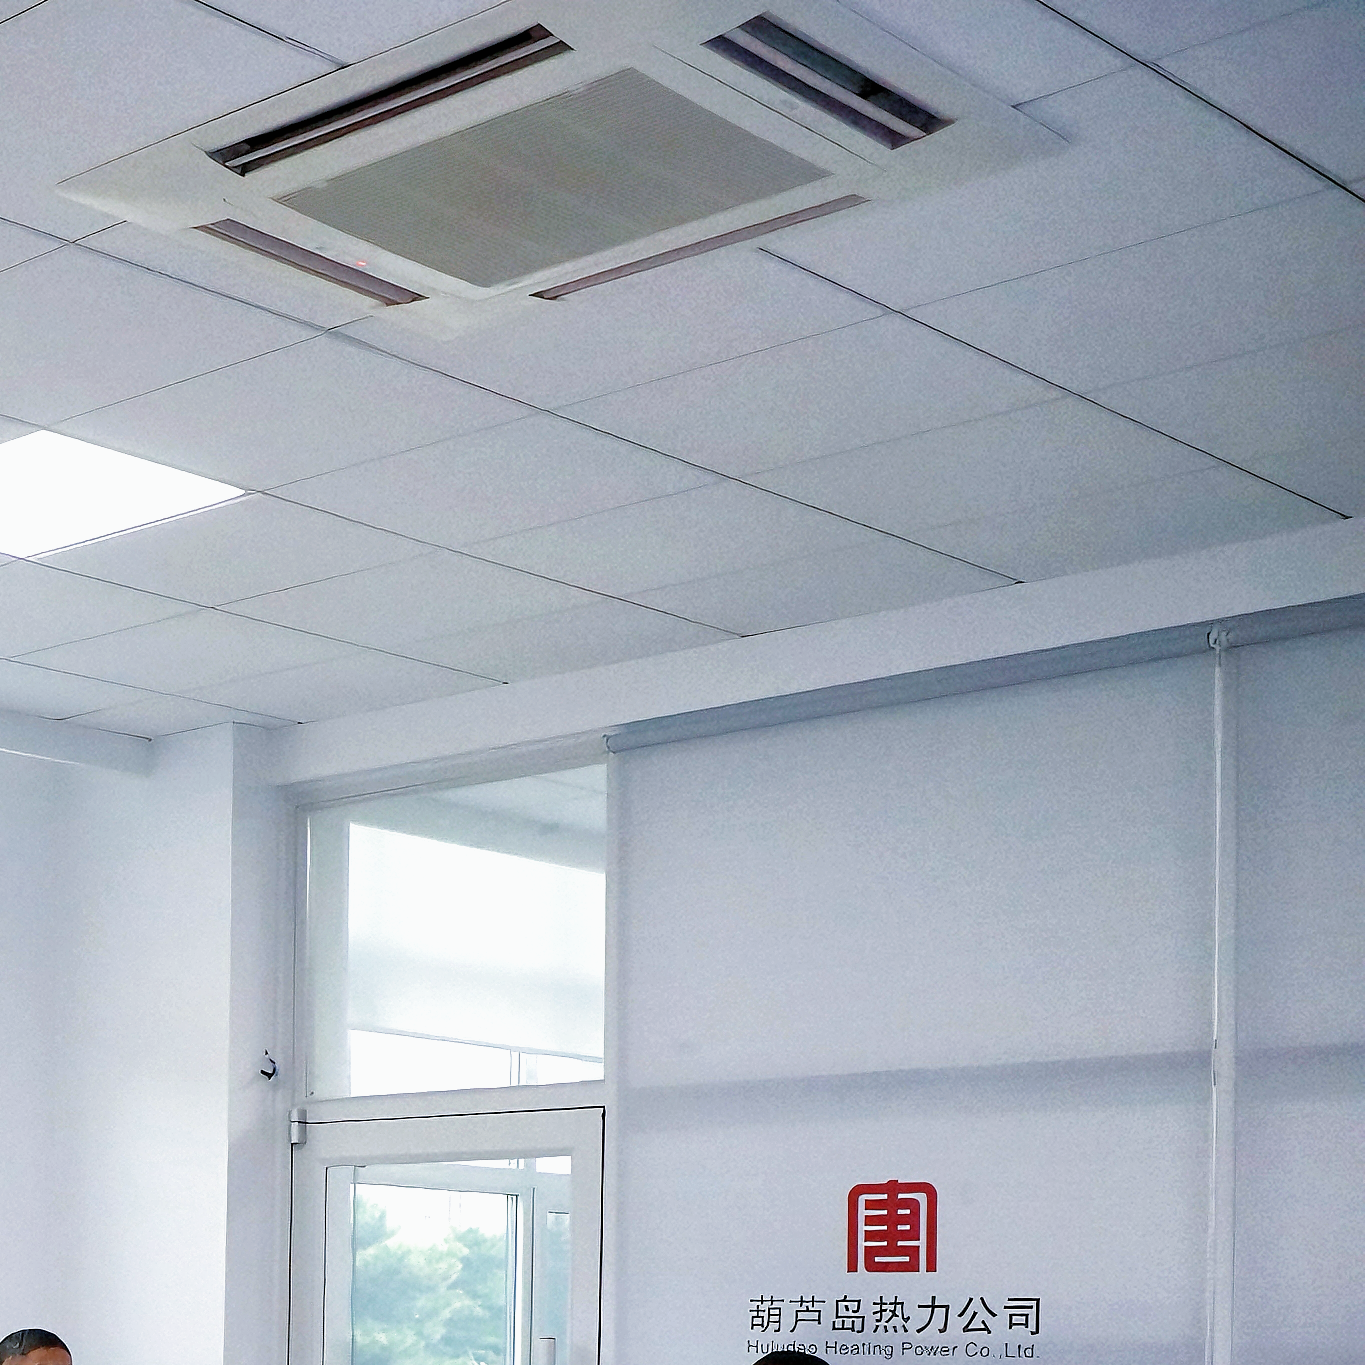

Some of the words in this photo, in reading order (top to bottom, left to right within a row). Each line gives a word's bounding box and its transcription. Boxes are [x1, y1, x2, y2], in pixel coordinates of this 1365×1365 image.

[749, 1294, 1041, 1336] 葫芦岛热力公司
[825, 1341, 894, 1360] Heating
[901, 1342, 959, 1357] Power
